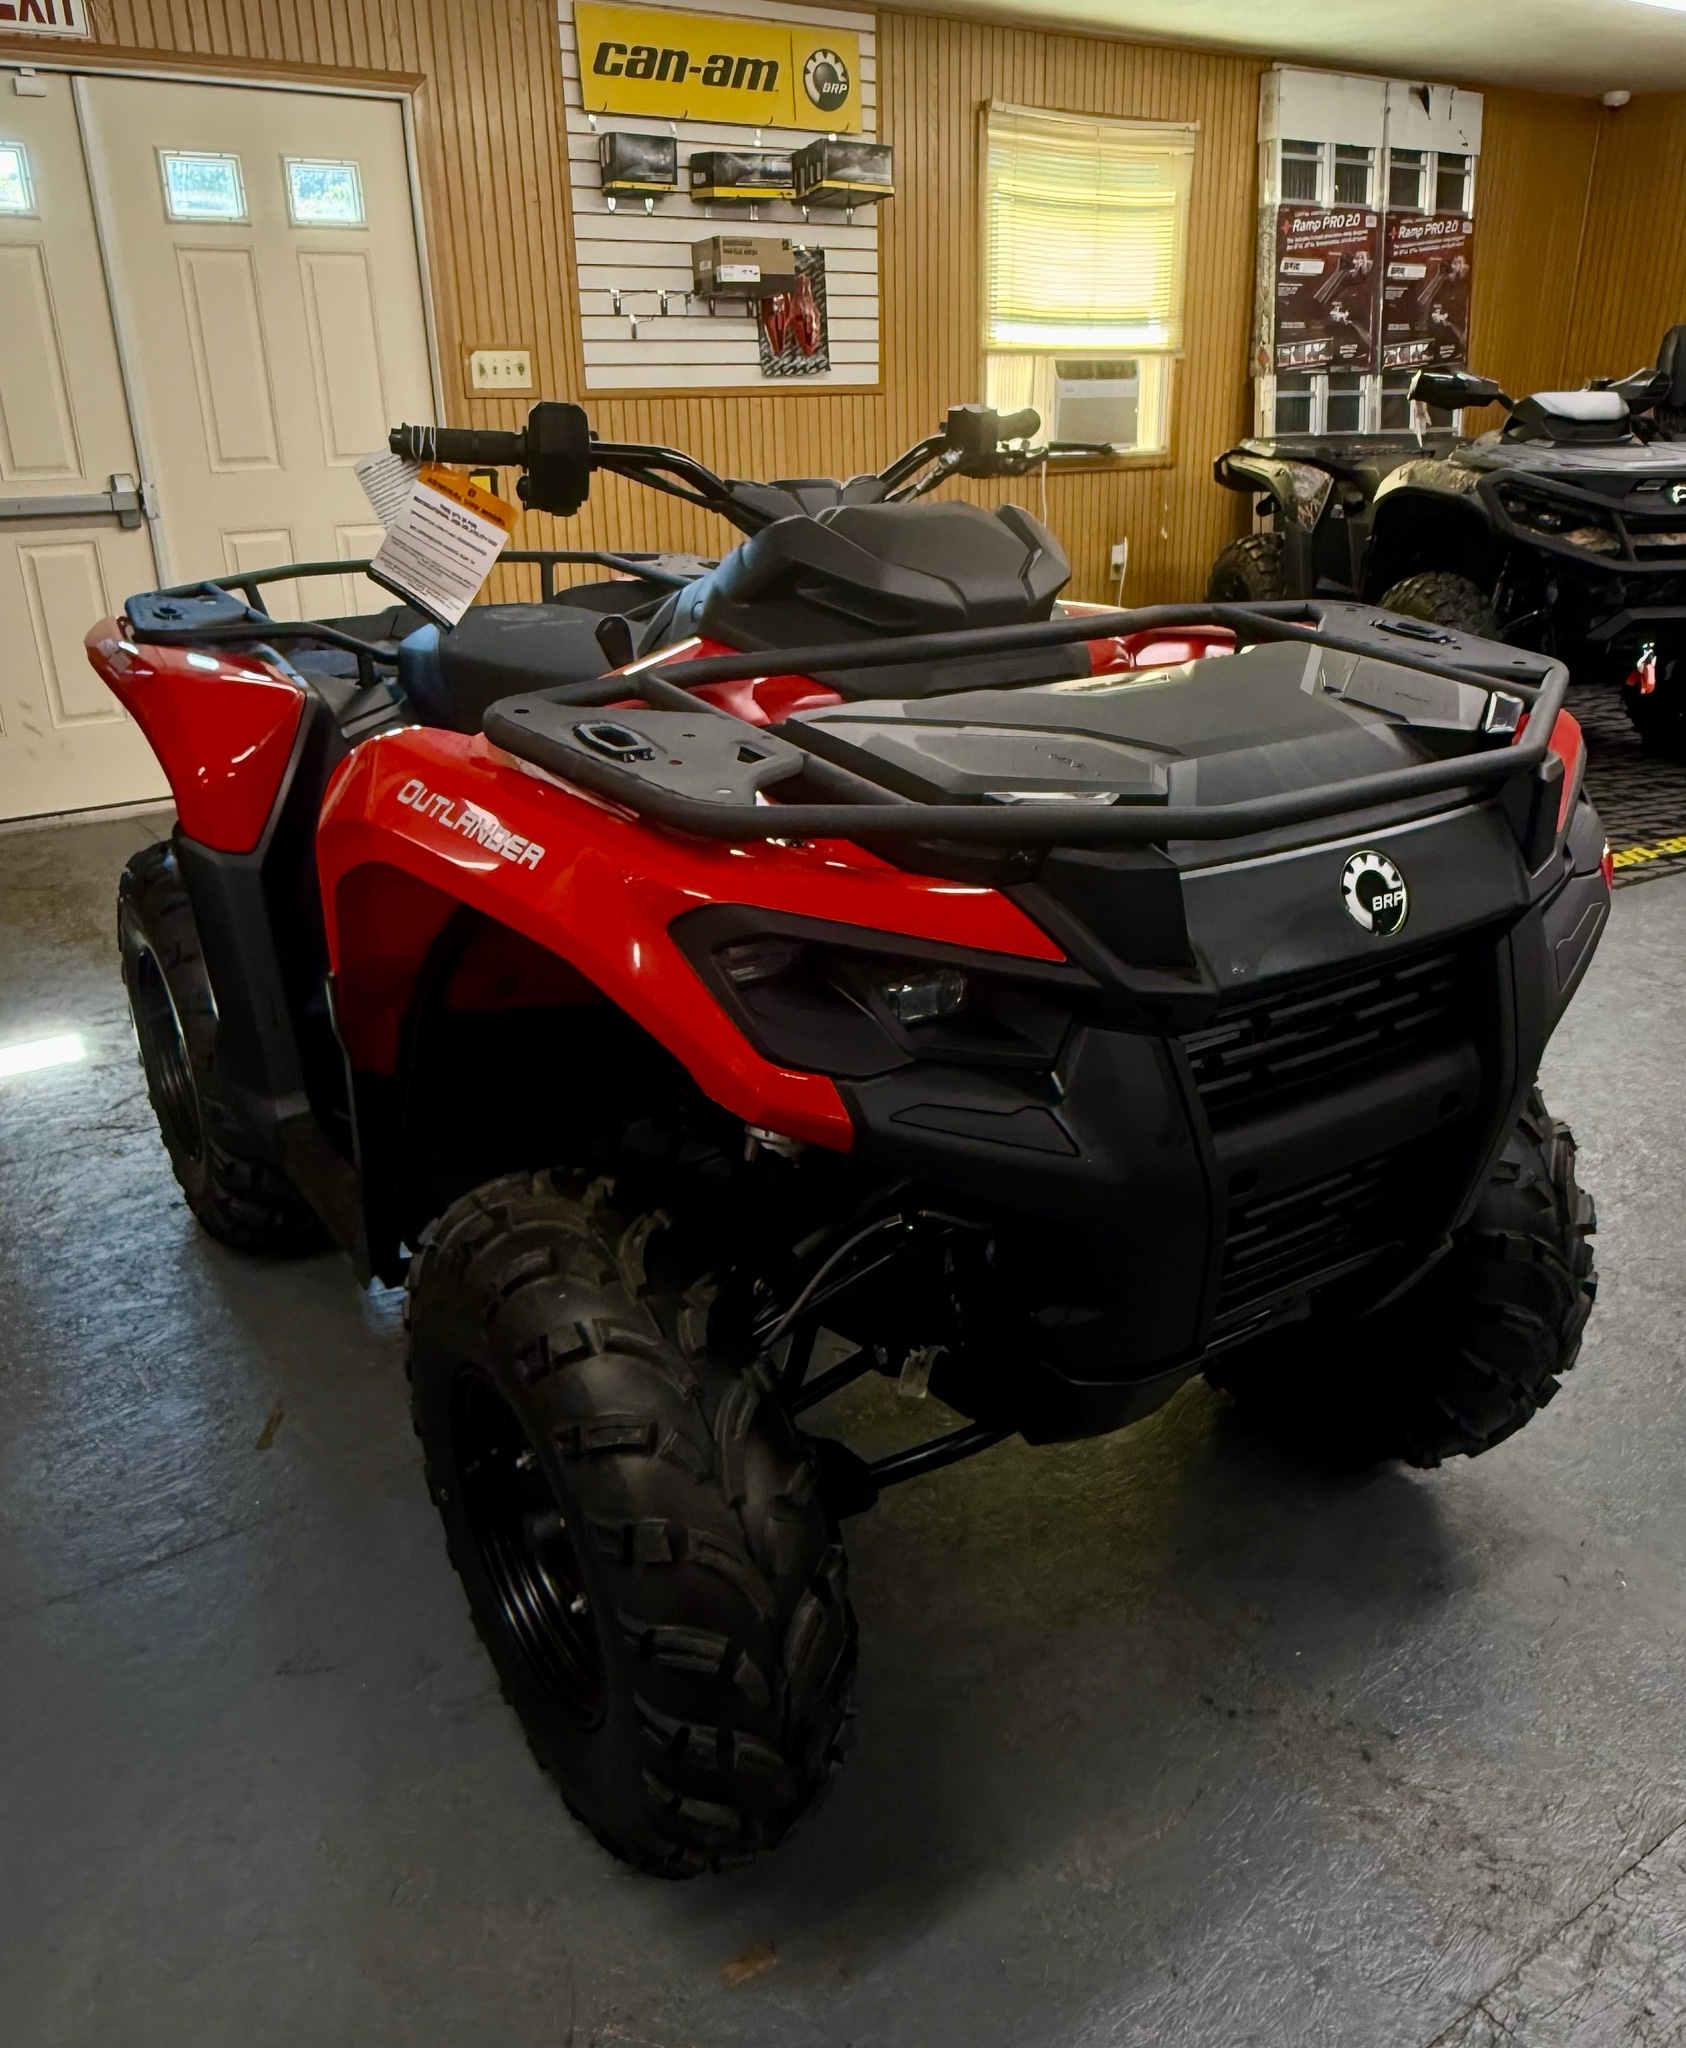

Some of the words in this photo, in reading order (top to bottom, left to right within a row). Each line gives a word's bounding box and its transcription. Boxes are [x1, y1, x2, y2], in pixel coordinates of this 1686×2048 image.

[593, 41, 779, 92] can-am
[822, 81, 848, 95] BRP
[1292, 218, 1321, 233] Ramp
[1322, 214, 1345, 230] PRO
[1397, 225, 1424, 240] Ramp
[1424, 220, 1445, 235] PRO
[397, 778, 546, 871] OUTLANDER
[1372, 890, 1404, 912] BRP
